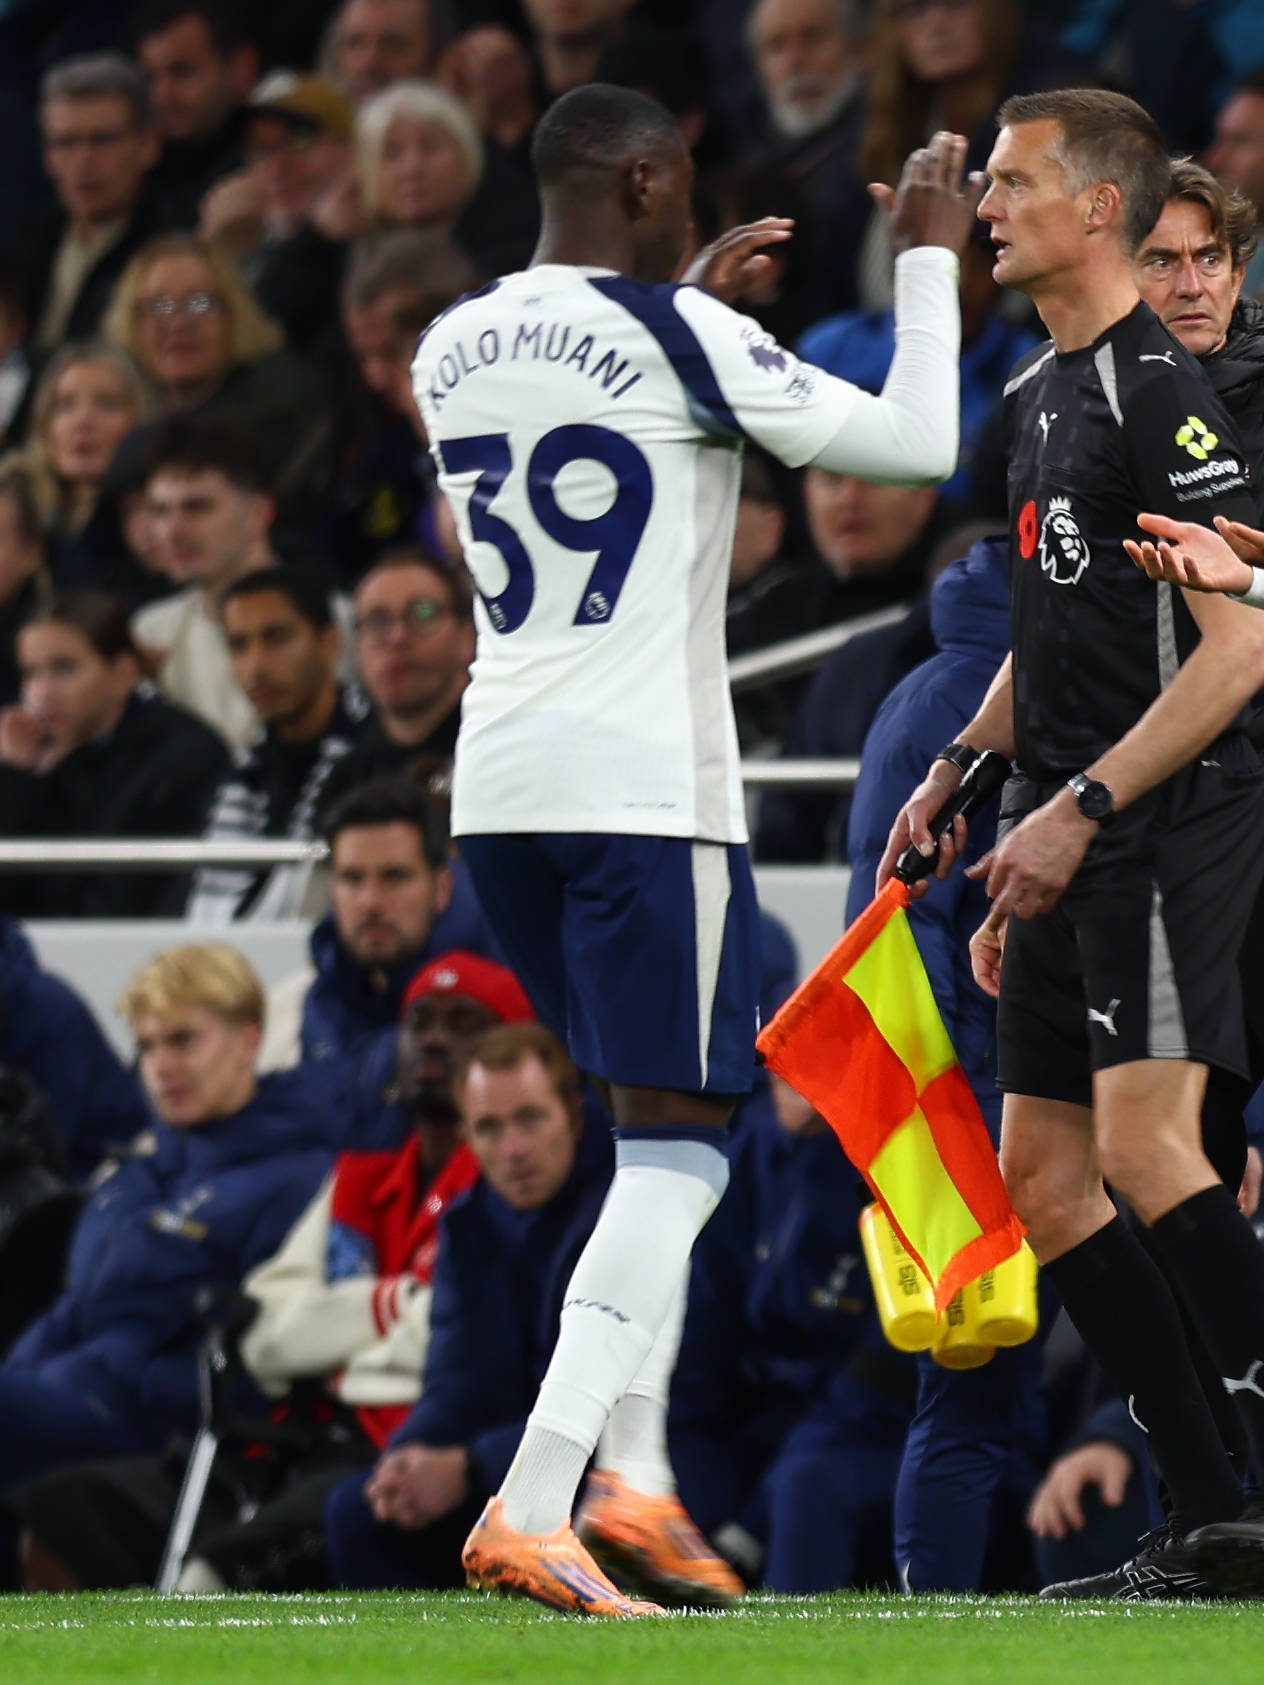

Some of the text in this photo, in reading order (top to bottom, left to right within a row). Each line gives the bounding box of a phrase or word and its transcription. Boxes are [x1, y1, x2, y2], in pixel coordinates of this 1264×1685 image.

[427, 321, 644, 411] KOLO MUANI
[1168, 459, 1239, 487] HuwsGray
[438, 423, 655, 635] 39
